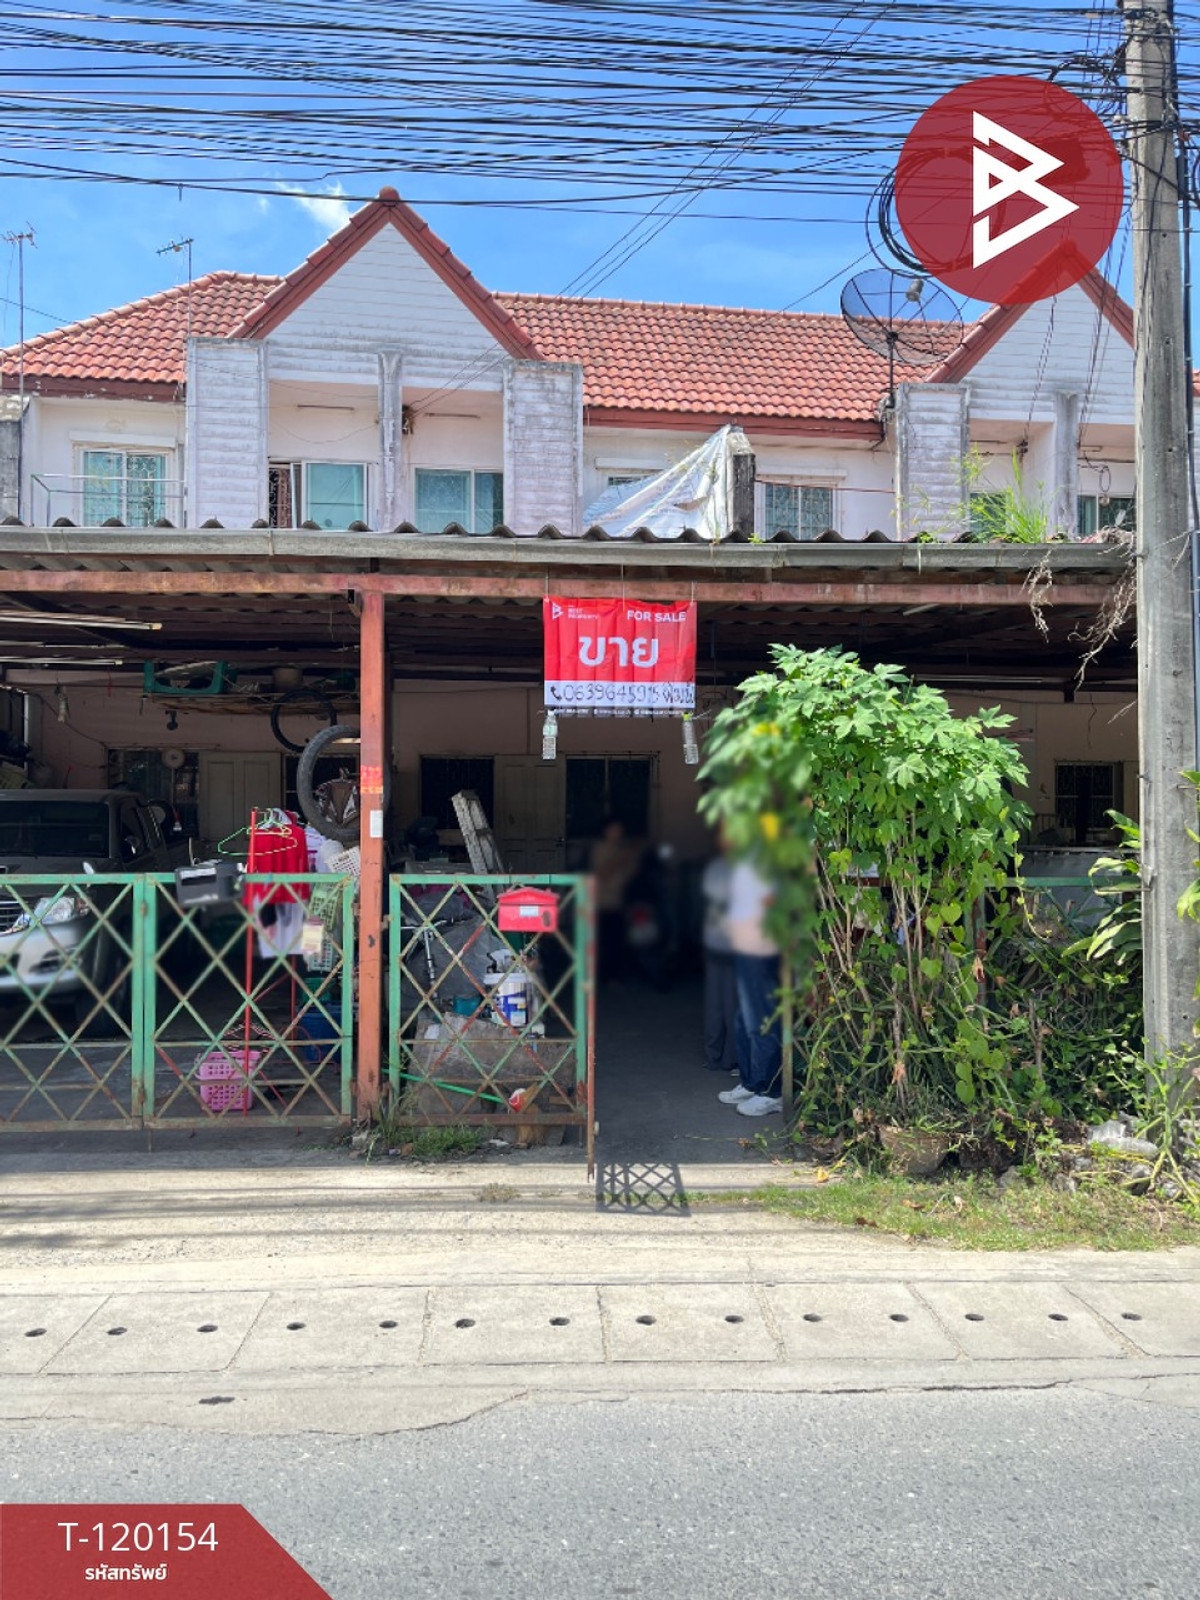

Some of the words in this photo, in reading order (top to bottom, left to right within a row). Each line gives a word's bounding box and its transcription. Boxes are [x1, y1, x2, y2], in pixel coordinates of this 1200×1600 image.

[627, 610, 652, 622] FOR
[654, 611, 687, 622] SALE
[579, 637, 659, 667] ขาย
